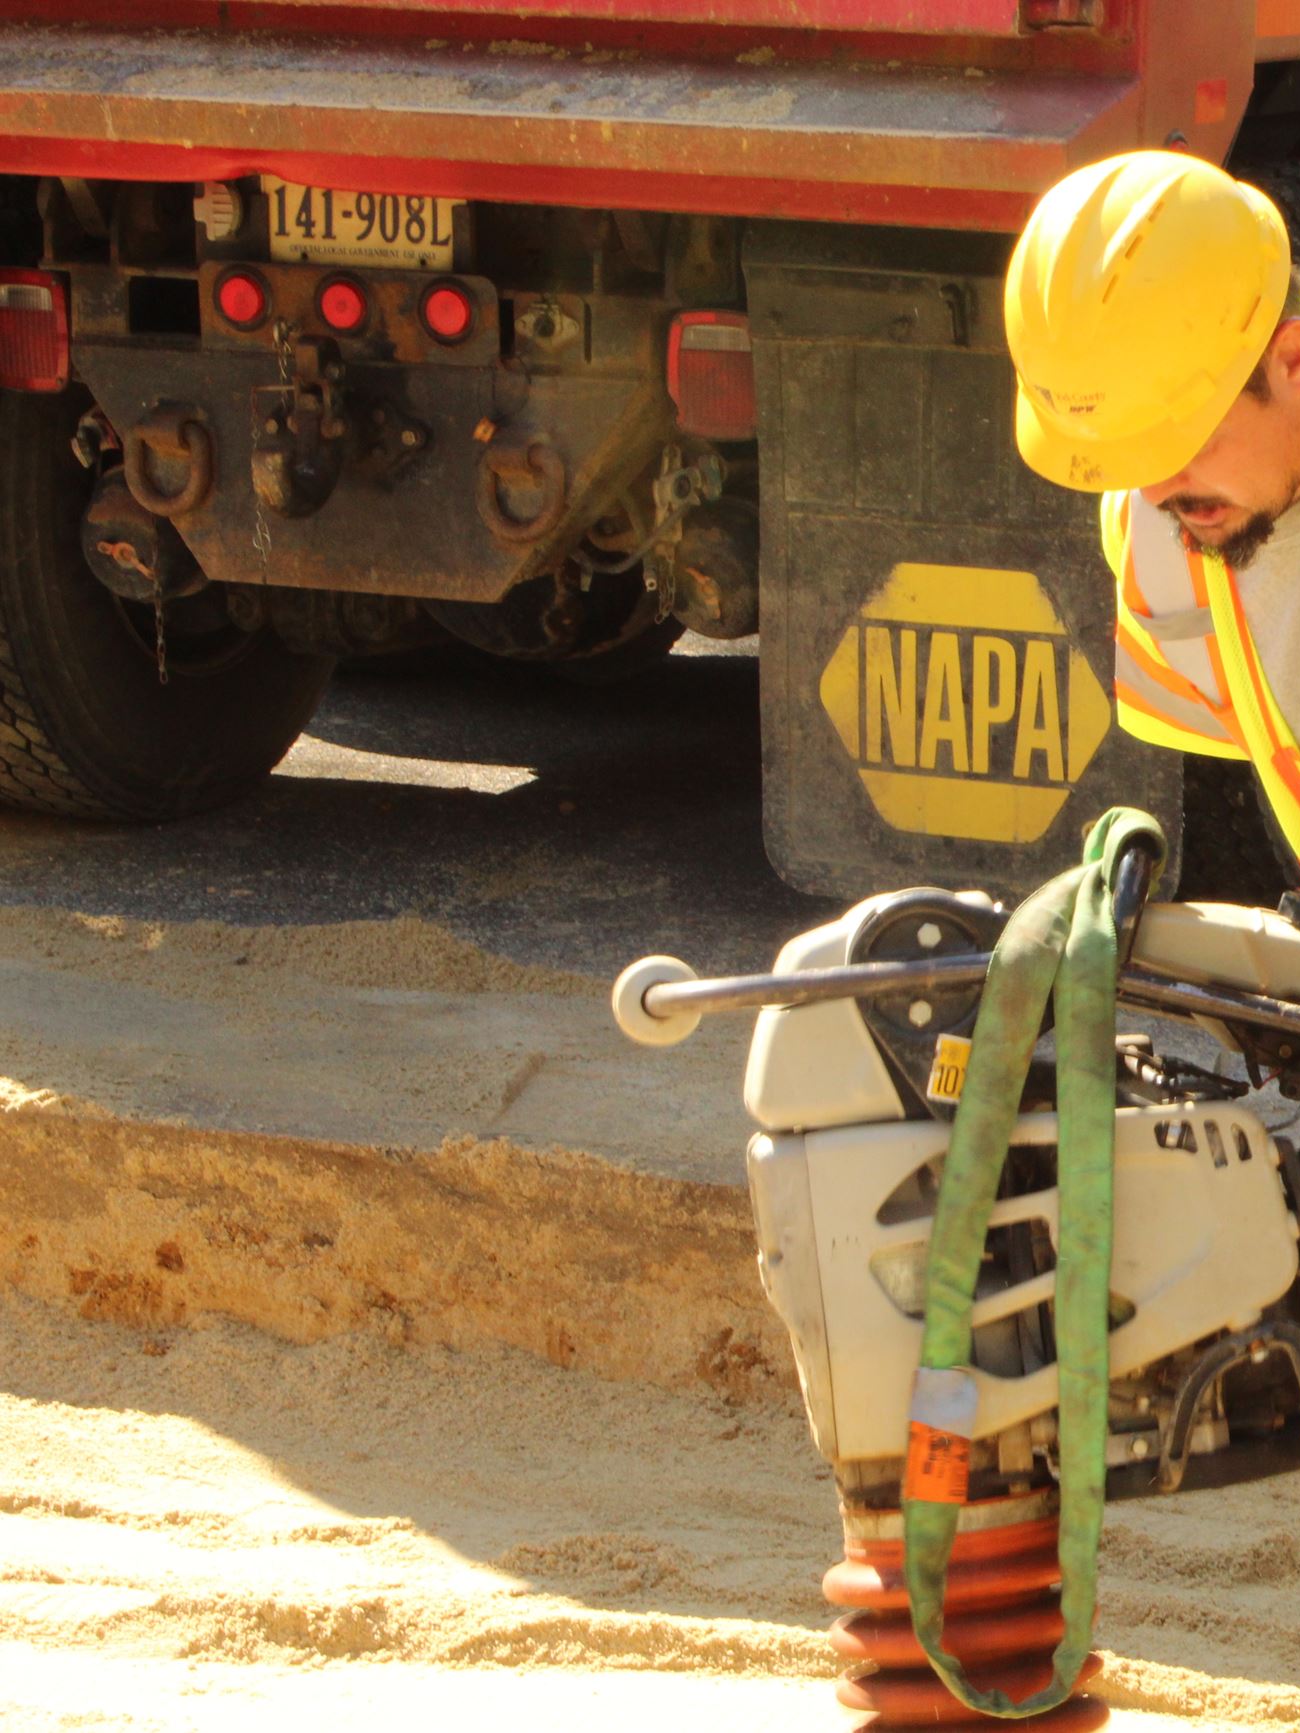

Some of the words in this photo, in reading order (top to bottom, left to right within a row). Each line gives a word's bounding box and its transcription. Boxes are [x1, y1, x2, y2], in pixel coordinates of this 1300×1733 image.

[274, 184, 452, 246] 141-908L
[321, 246, 346, 256] LOCAL
[348, 247, 399, 258] GOVERNMENT
[865, 626, 1065, 781] NAPA
[936, 1064, 966, 1096] 10
